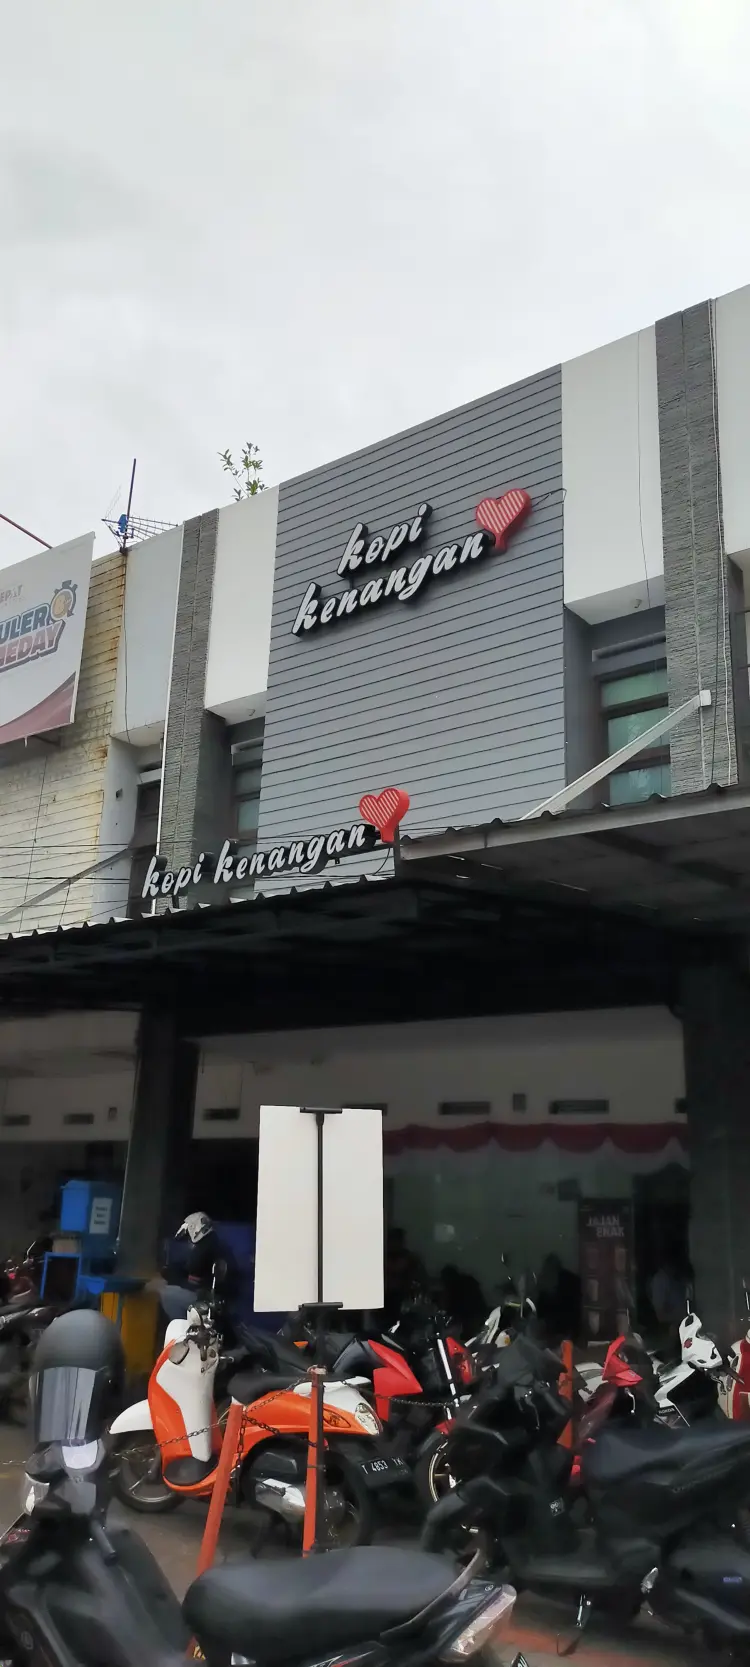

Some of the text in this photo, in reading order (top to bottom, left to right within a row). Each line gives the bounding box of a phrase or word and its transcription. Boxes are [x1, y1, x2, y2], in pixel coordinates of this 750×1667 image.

[337, 503, 428, 575] kopi
[292, 532, 485, 635] kenangan
[142, 824, 366, 899] kopi kenangan
